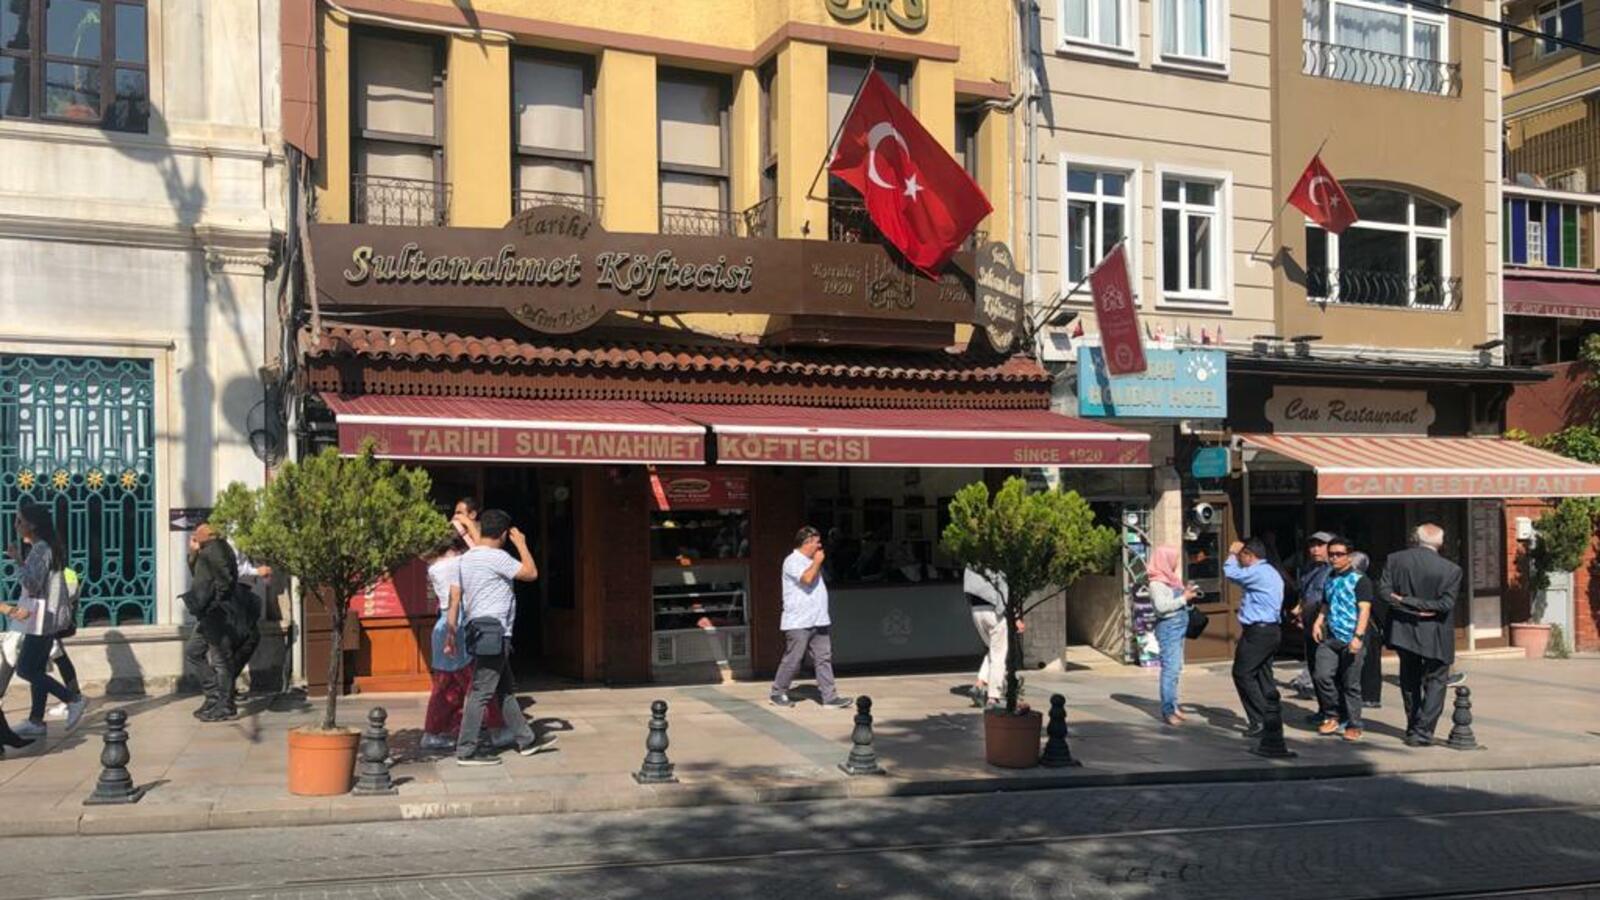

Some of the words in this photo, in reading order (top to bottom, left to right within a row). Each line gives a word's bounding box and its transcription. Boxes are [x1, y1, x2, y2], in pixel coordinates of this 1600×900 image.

[518, 211, 592, 240] Tarihi
[343, 242, 581, 286] Sultanahmet
[595, 249, 754, 298] Köftecisi
[821, 279, 853, 296] 1920
[1284, 397, 1321, 421] Can
[1327, 400, 1419, 426] Restaurant
[408, 426, 499, 455] TARİHİ
[515, 432, 701, 460] SULTANAHMET
[719, 432, 870, 462] KÖFTECİSİ
[1069, 449, 1104, 463] 1920
[1343, 475, 1404, 495] CAN
[1412, 475, 1586, 495] RESTAURANT
